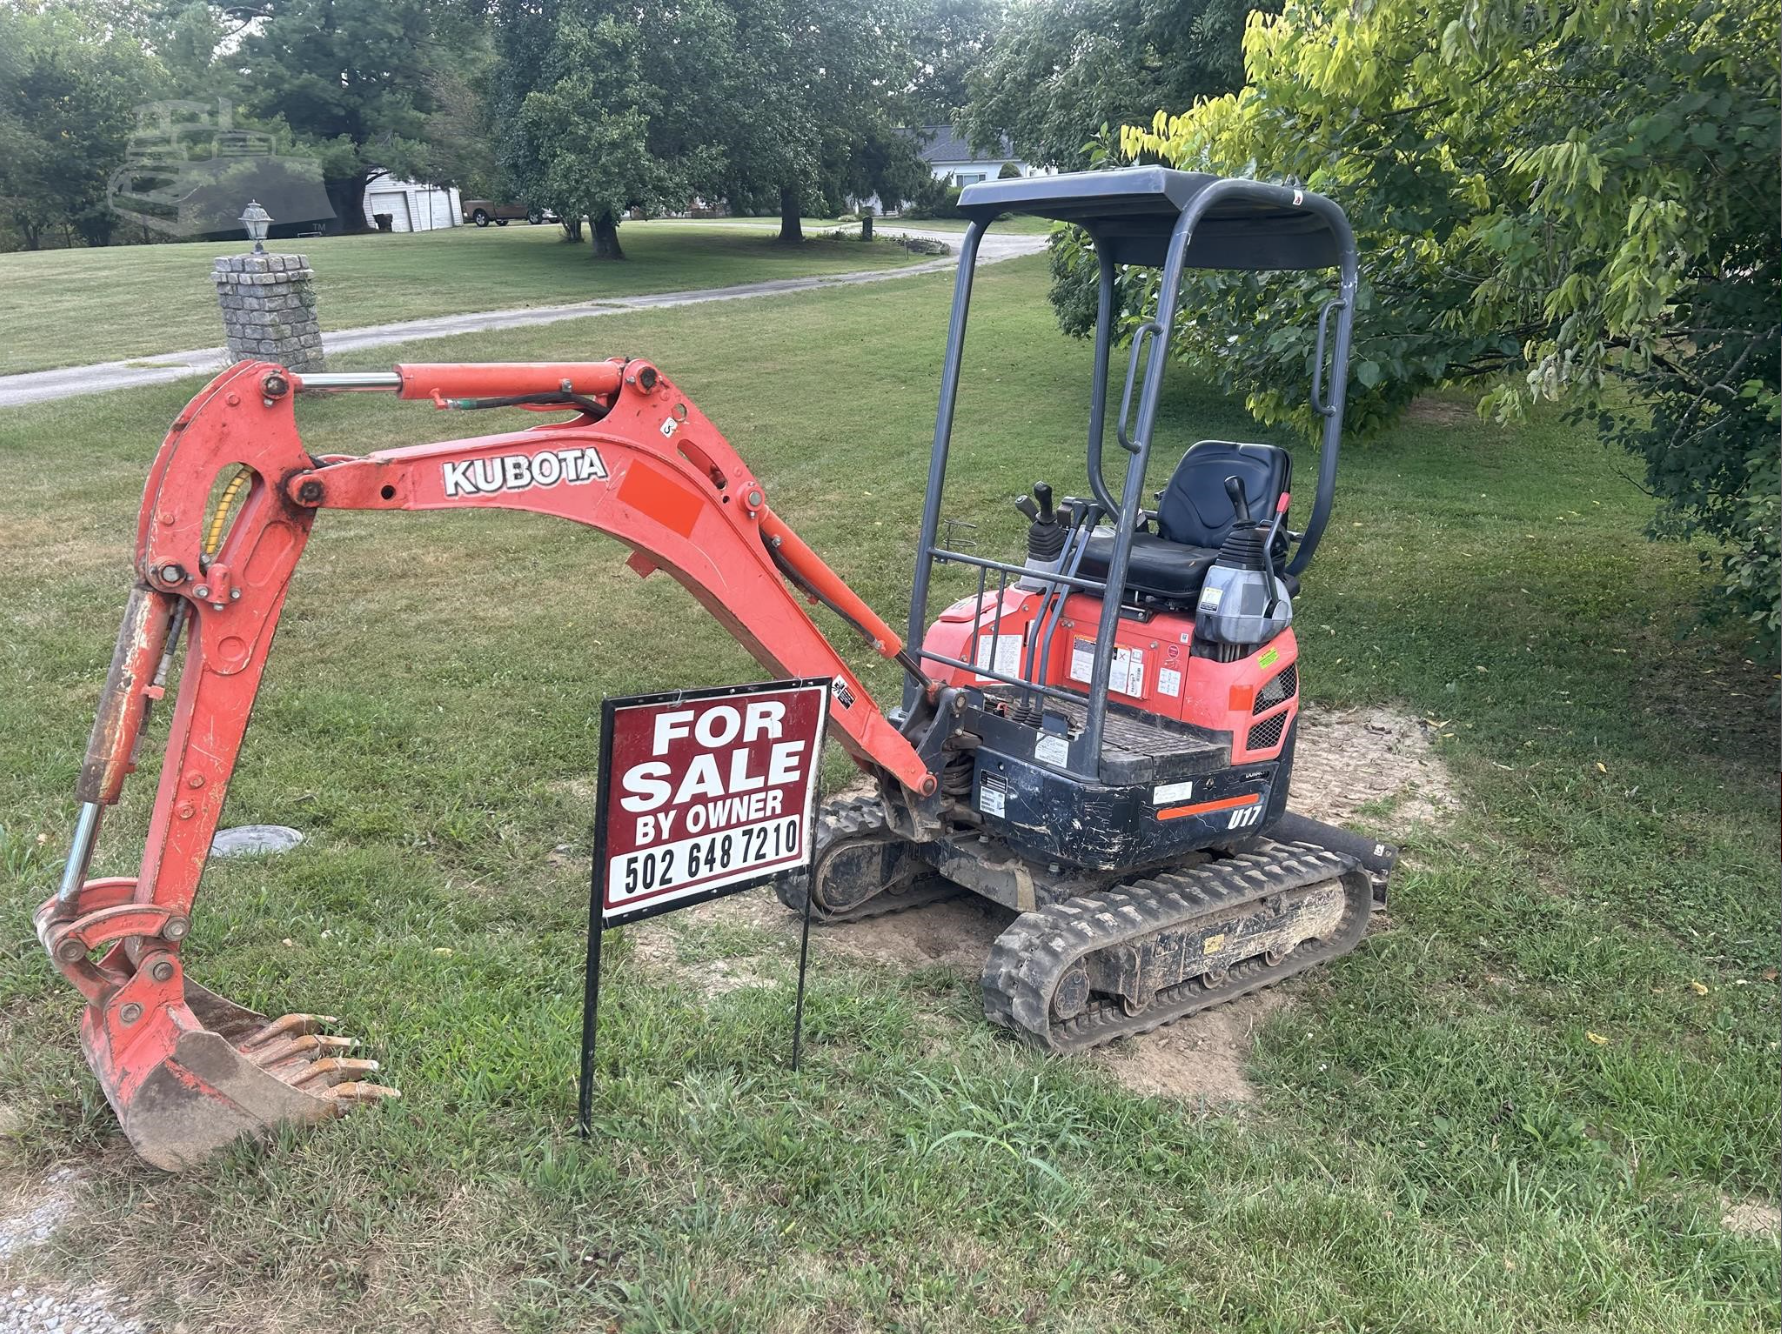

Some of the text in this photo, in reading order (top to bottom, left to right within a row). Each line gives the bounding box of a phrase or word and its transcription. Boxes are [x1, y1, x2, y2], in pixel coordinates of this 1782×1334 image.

[442, 447, 608, 496] KUBOTA
[652, 701, 786, 756] FOR
[620, 740, 806, 813] SALE
[635, 789, 784, 846] BY OWNER
[1227, 805, 1262, 830] U17
[624, 819, 797, 895] 502 648 7210
